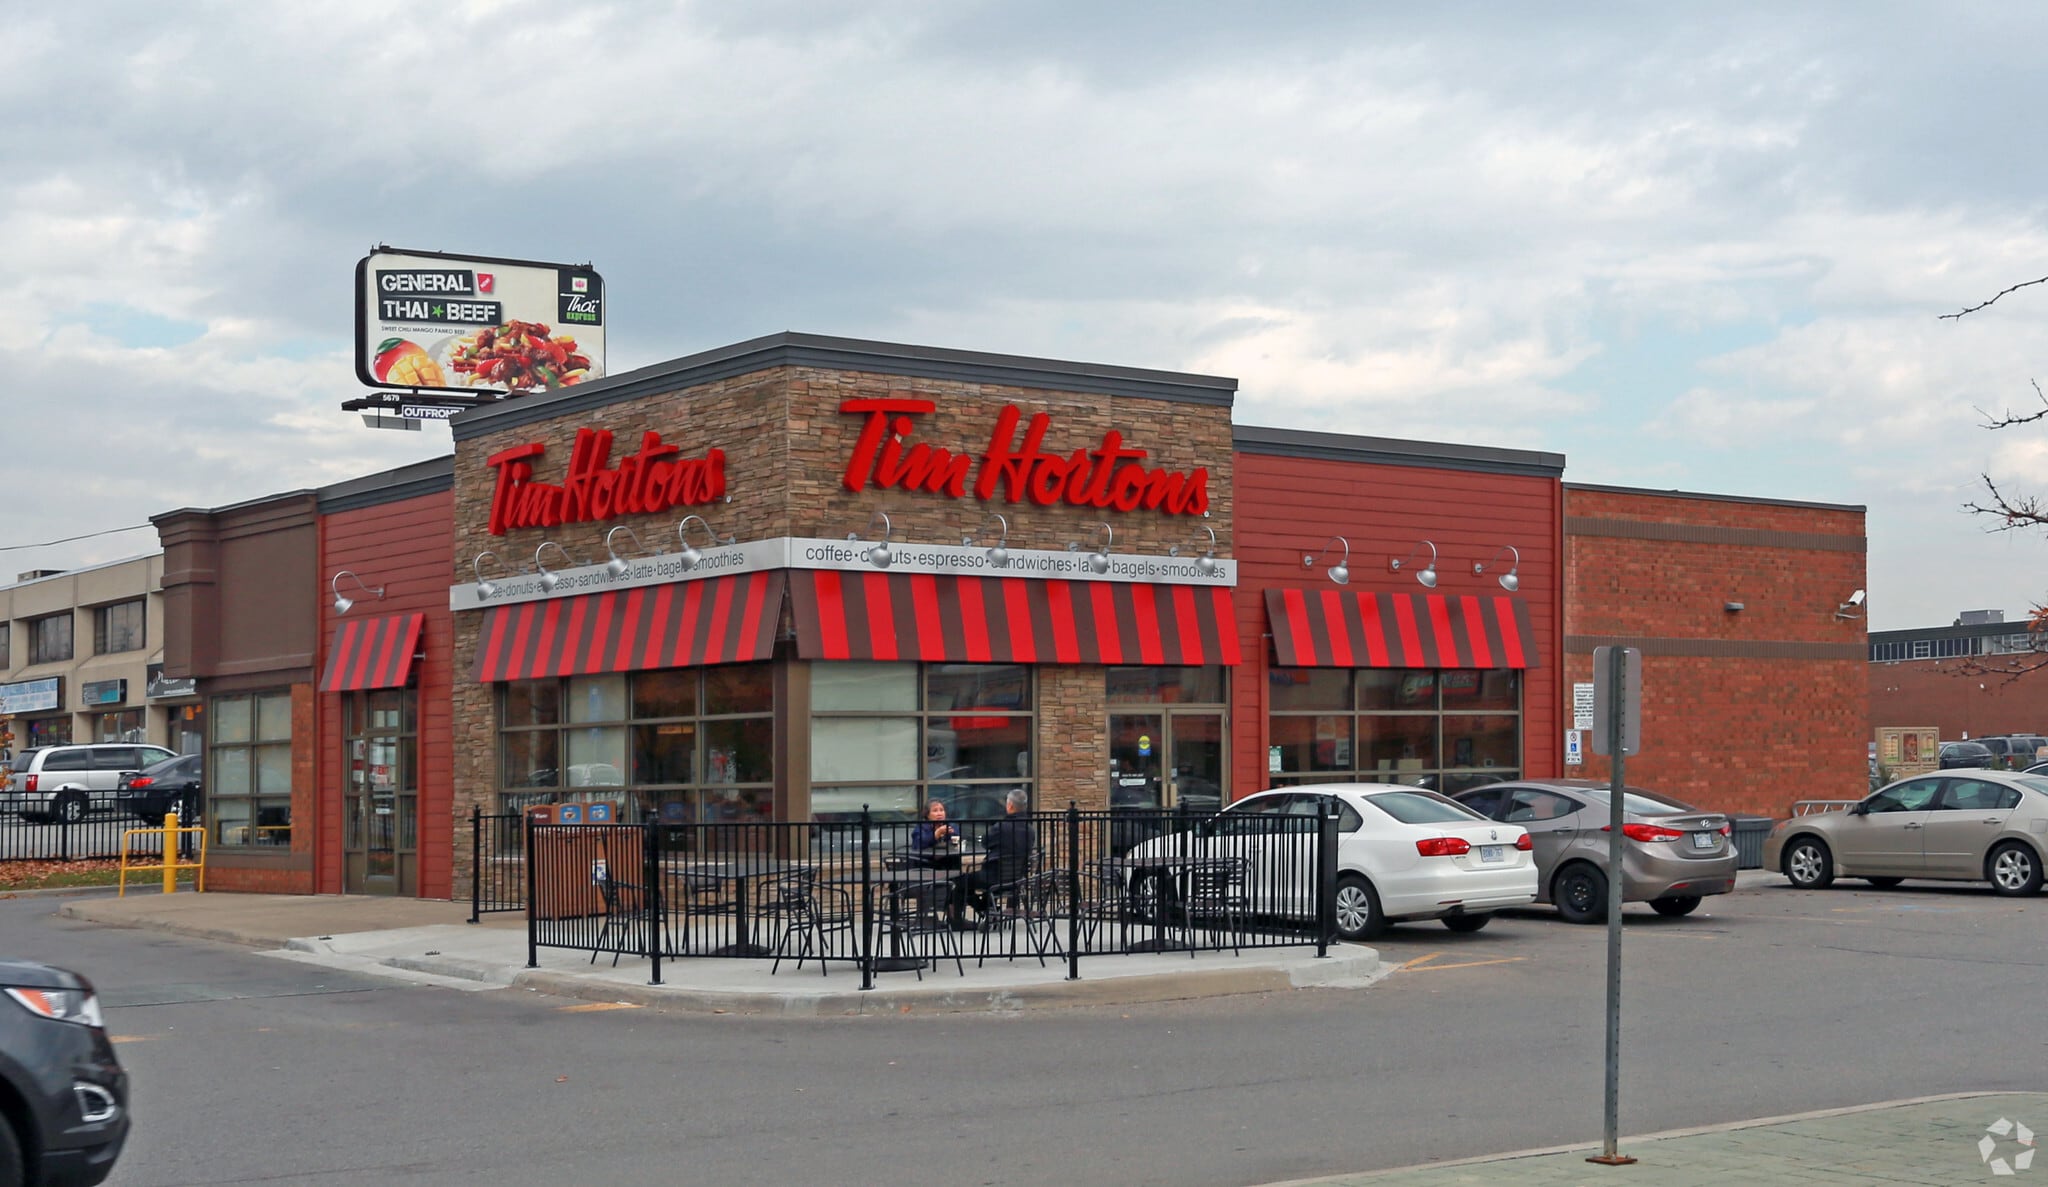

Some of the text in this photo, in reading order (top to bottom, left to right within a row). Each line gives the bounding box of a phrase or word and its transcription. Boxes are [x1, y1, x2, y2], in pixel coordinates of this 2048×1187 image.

[381, 273, 472, 292] GENERAL
[383, 300, 496, 322] THAI BEEF
[566, 312, 597, 321] express
[839, 399, 1209, 515] Tim Hortons
[487, 428, 727, 536] Tim Hortons
[805, 544, 853, 561] coffee
[859, 546, 912, 565] duts
[918, 552, 984, 570] espresso
[991, 554, 1072, 572] ndwiches
[1112, 560, 1156, 578] bagels
[505, 581, 534, 597] donuts
[536, 577, 575, 592] eesso
[633, 561, 653, 579] latte
